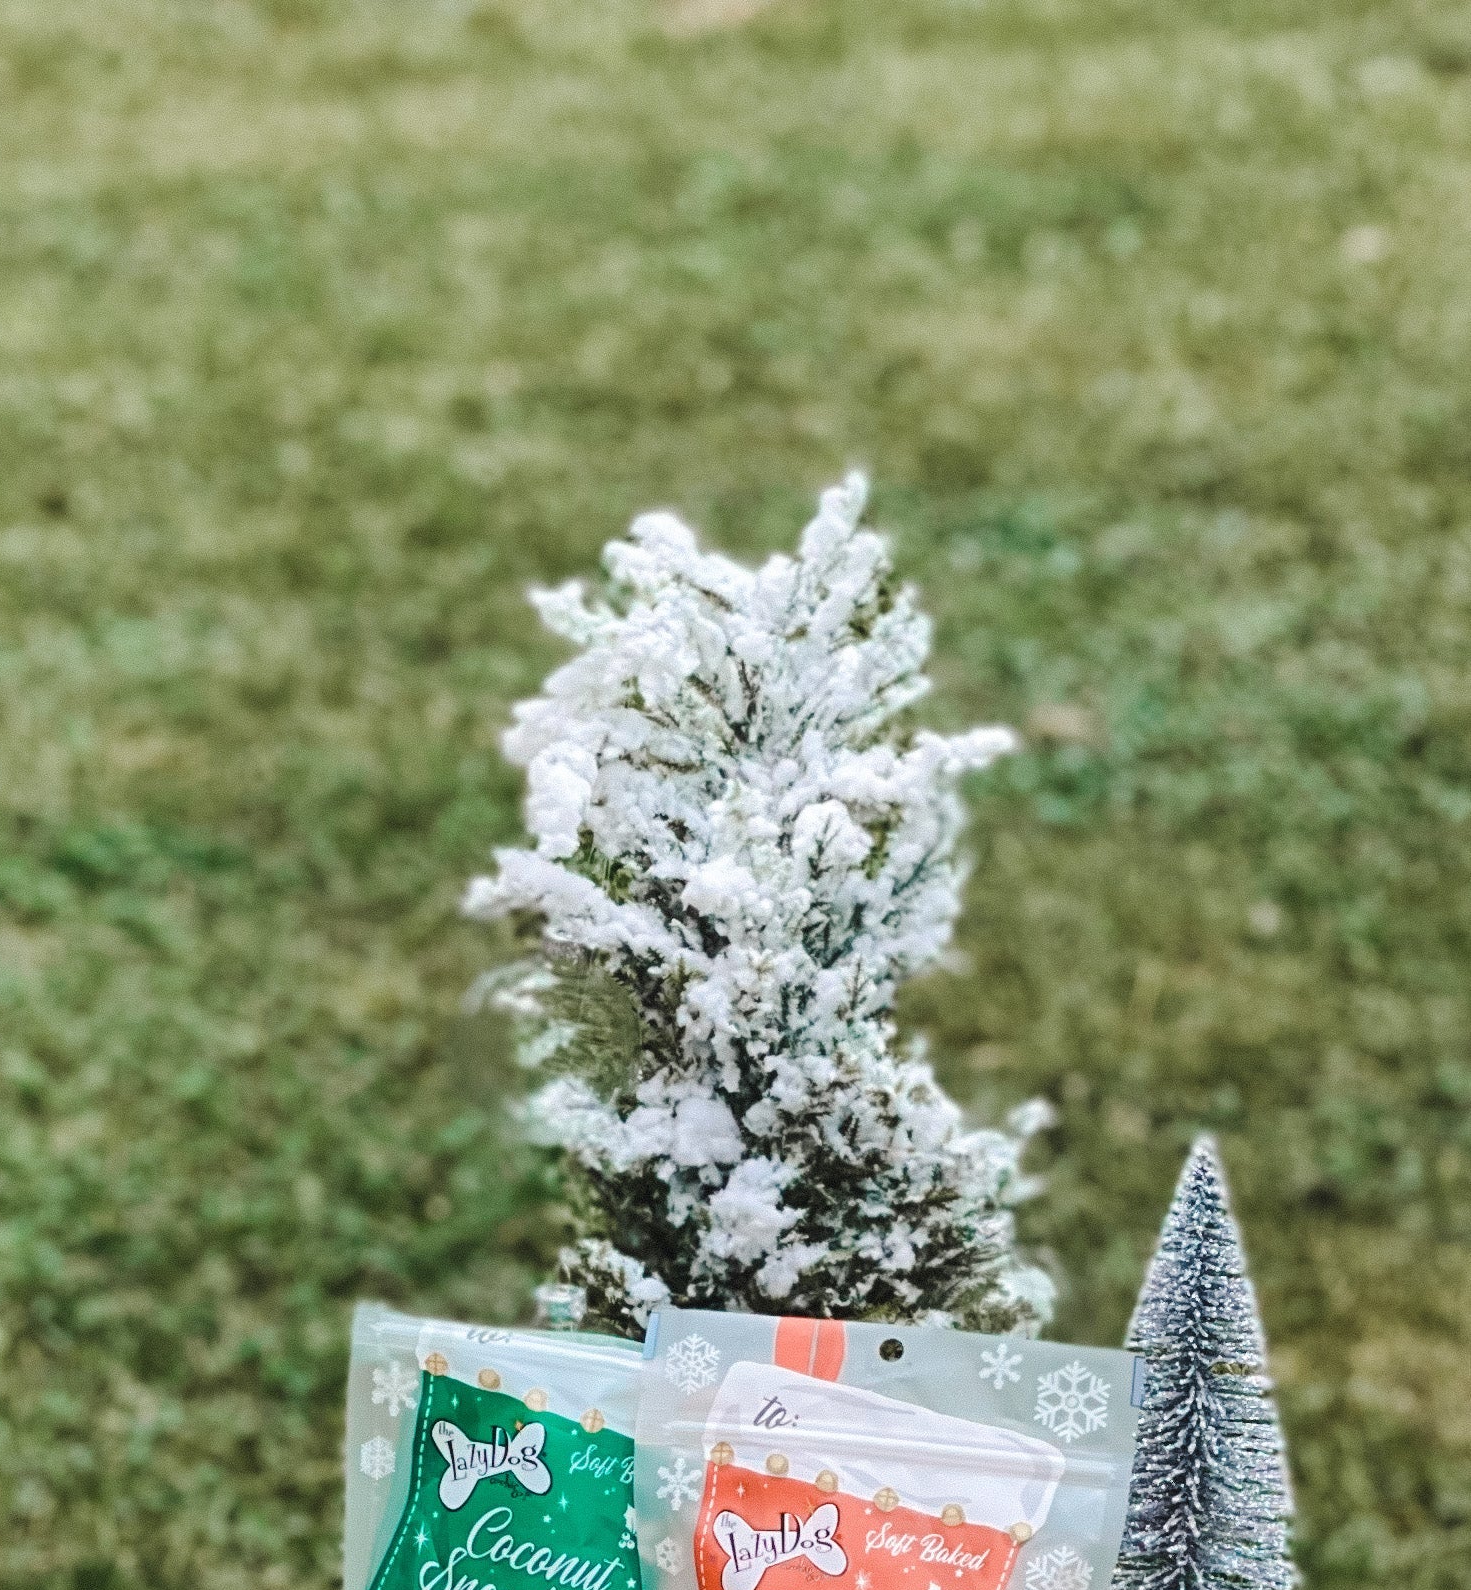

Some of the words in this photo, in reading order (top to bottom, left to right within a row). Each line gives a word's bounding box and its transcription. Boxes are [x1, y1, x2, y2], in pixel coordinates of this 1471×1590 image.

[753, 1396, 799, 1429] to:
[569, 1444, 619, 1478] Soft
[865, 1522, 917, 1557] Soft
[919, 1534, 990, 1570] Baked
